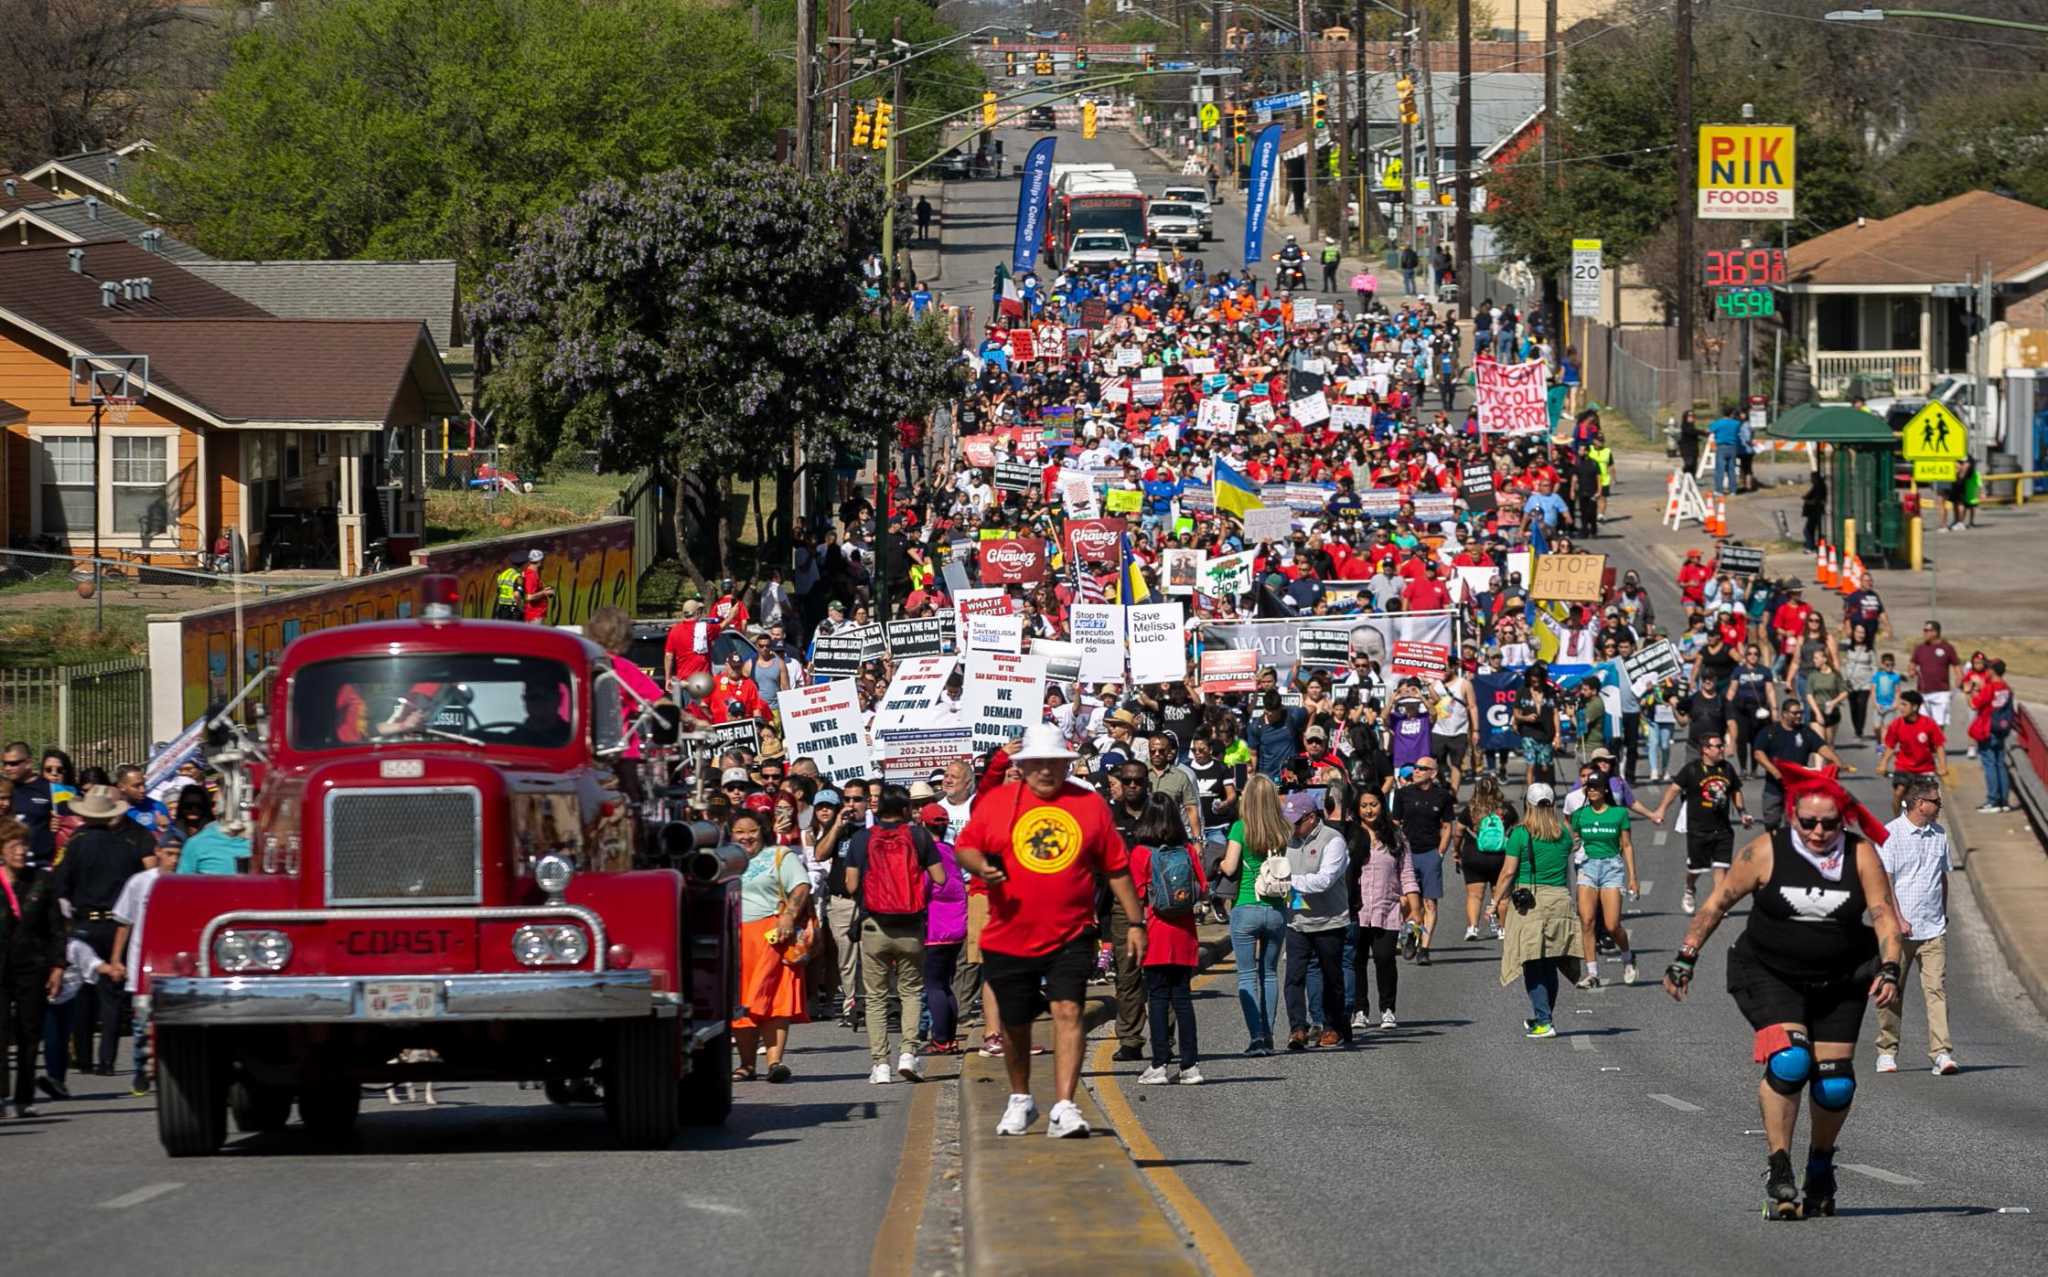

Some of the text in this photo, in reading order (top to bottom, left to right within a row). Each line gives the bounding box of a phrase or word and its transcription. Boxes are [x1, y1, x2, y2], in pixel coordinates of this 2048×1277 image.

[1034, 153, 1046, 167] St.
[1706, 190, 1779, 204] FOODS
[1023, 206, 1038, 242] College
[1575, 265, 1599, 279] 20
[1464, 466, 1490, 477] FREE
[1921, 465, 1951, 473] AHEAD
[1070, 528, 1118, 545] Chavez
[986, 549, 1036, 567] Chavez
[1540, 557, 1599, 573] STOP
[967, 600, 991, 610] WHAT
[1075, 611, 1095, 619] Stop
[1133, 611, 1160, 621] Save
[889, 623, 911, 634] WATCH
[911, 621, 924, 632] THE
[924, 619, 938, 630] FILM
[1133, 622, 1176, 632] Melissa
[1232, 635, 1294, 656] WATC
[1394, 658, 1446, 670] EXECUTED?
[997, 688, 1013, 701] WE
[885, 699, 930, 711] FIGHTING FOR
[983, 705, 1022, 719] DEMAND
[716, 725, 754, 740] THE FILM
[809, 718, 838, 734] WE'RE
[974, 723, 1000, 736] GOOD
[797, 736, 840, 754] FIGHTING
[839, 733, 858, 746] FOR
[900, 745, 958, 755] 202-224-3121
[828, 755, 834, 765] A
[886, 761, 921, 769] FREEDOM
[834, 766, 865, 782] WAGE!
